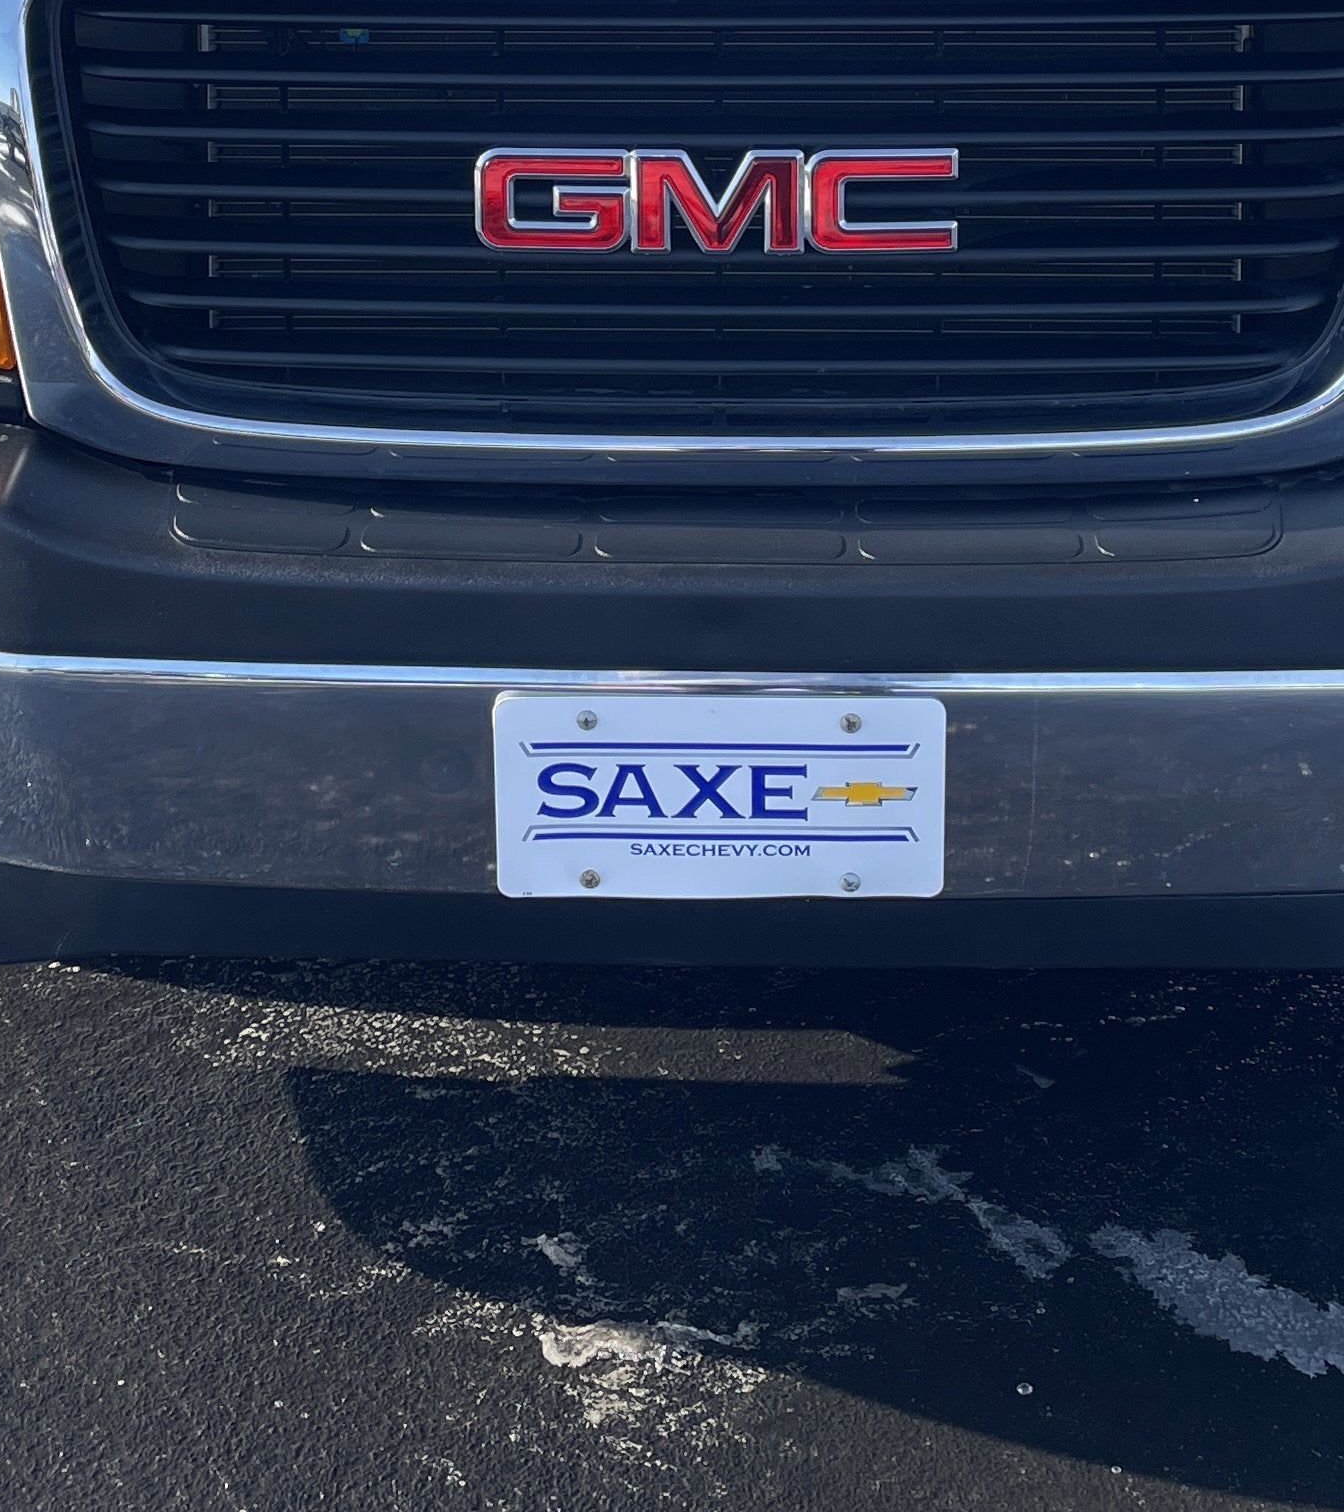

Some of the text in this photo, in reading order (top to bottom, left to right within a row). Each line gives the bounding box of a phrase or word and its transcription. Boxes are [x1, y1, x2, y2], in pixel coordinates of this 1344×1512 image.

[474, 147, 959, 253] GMC
[536, 762, 809, 822] SAXE
[629, 842, 812, 858] SAXECHEVY.COM
